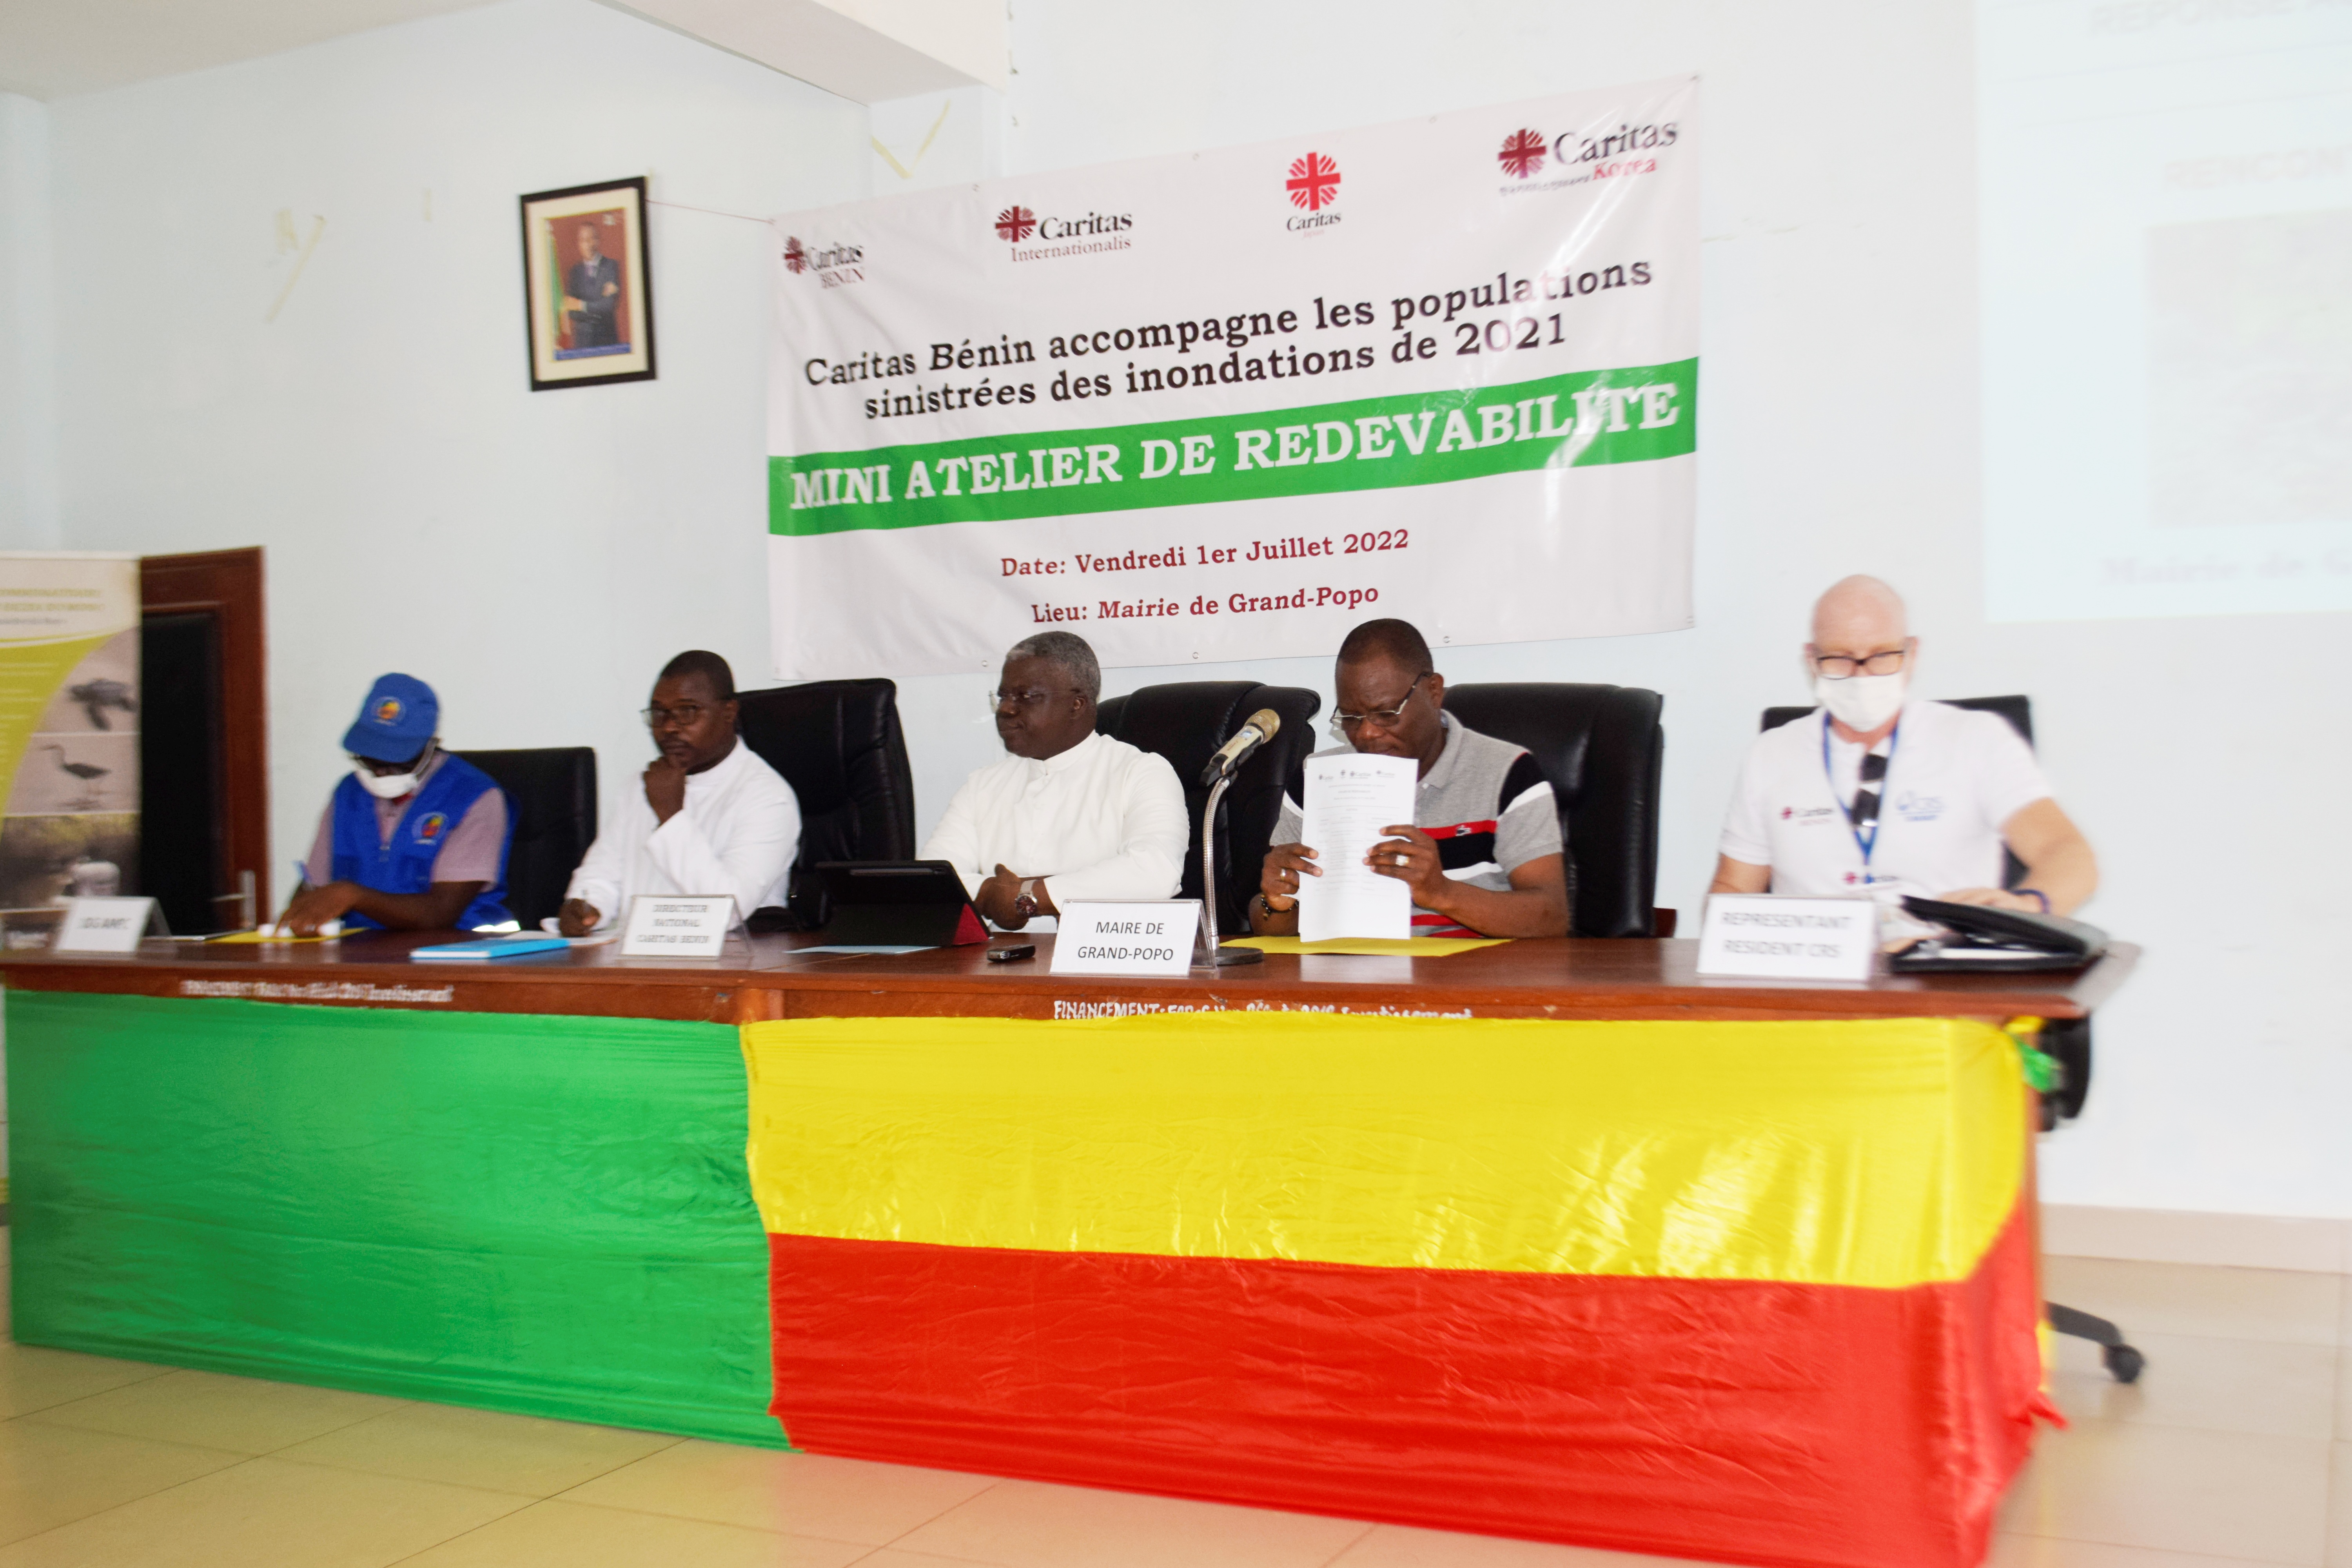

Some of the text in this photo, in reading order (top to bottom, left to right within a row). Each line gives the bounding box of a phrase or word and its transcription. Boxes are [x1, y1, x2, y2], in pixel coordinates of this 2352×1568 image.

[1553, 122, 1679, 165] Caritas
[1592, 157, 1657, 181] Korea
[1039, 211, 1132, 240] Caritas
[1287, 212, 1341, 232] Caritas
[806, 241, 864, 271] Caritas
[1011, 236, 1132, 263] Internationalis
[805, 260, 1652, 385] Caritas Bénin accompagne les populations
[865, 313, 1566, 419] sinistrées des inondations de 2021
[789, 383, 1680, 510] MINI ATELIER DE REDEVABILITE
[1001, 528, 1409, 577] Date: Vendredi 1er Juillet 2022
[1032, 587, 1379, 623] Lieu: Mairie de Grand-Popo
[1096, 922, 1164, 935] MAIRE DE
[1078, 946, 1174, 960] GRAND-POPO
